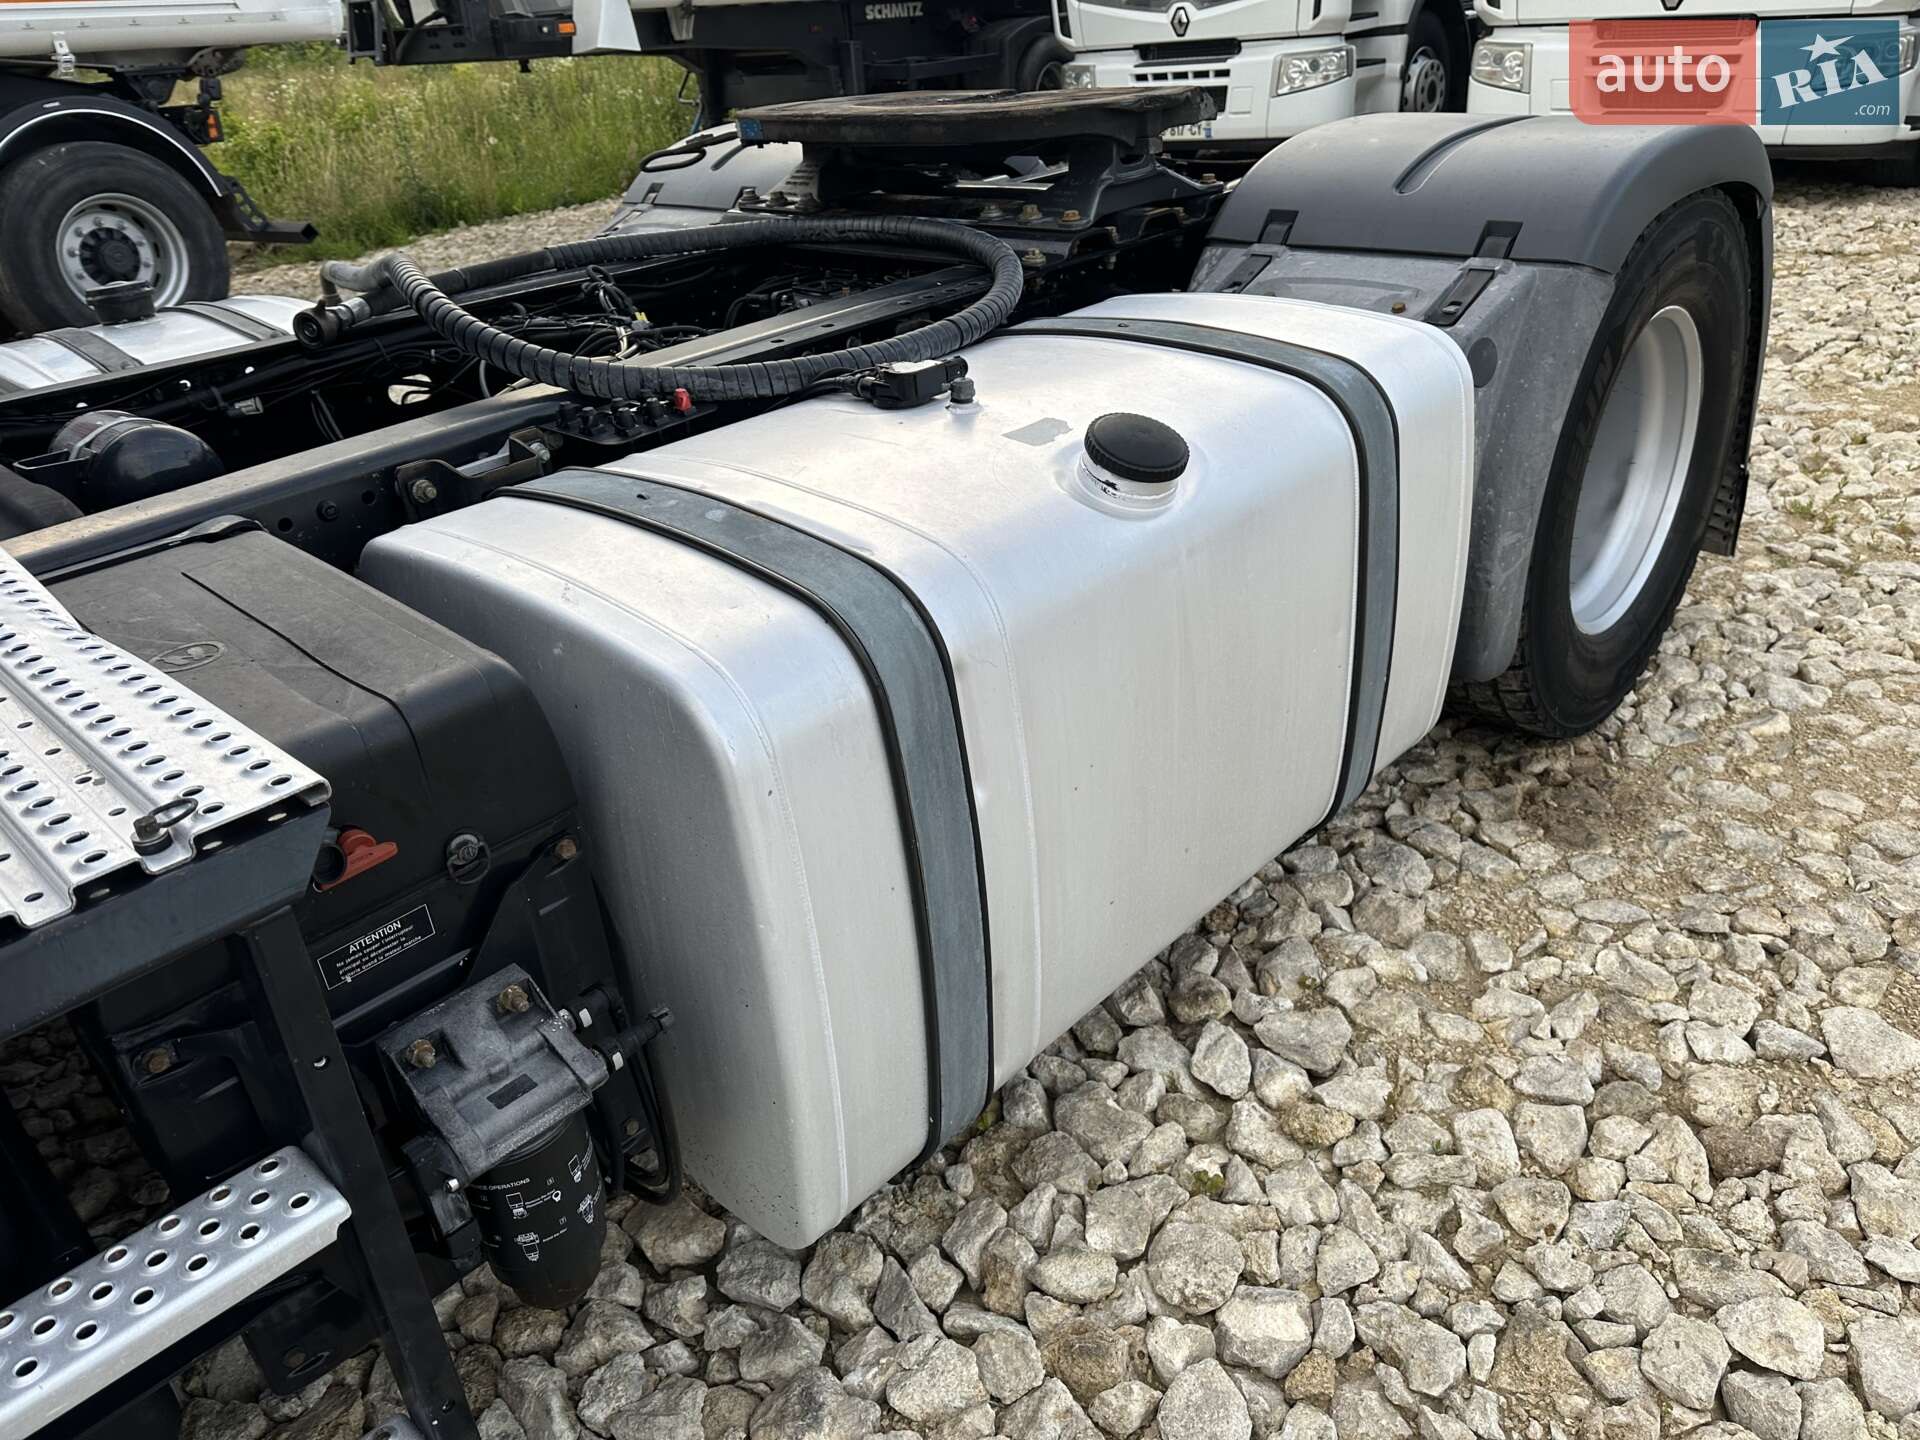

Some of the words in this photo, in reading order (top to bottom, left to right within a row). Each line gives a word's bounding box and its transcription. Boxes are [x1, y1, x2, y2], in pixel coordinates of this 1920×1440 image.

[865, 2, 923, 20] SCHMITZ
[349, 920, 401, 954] ATTENTION
[488, 1177, 531, 1190] OPERATIONS
